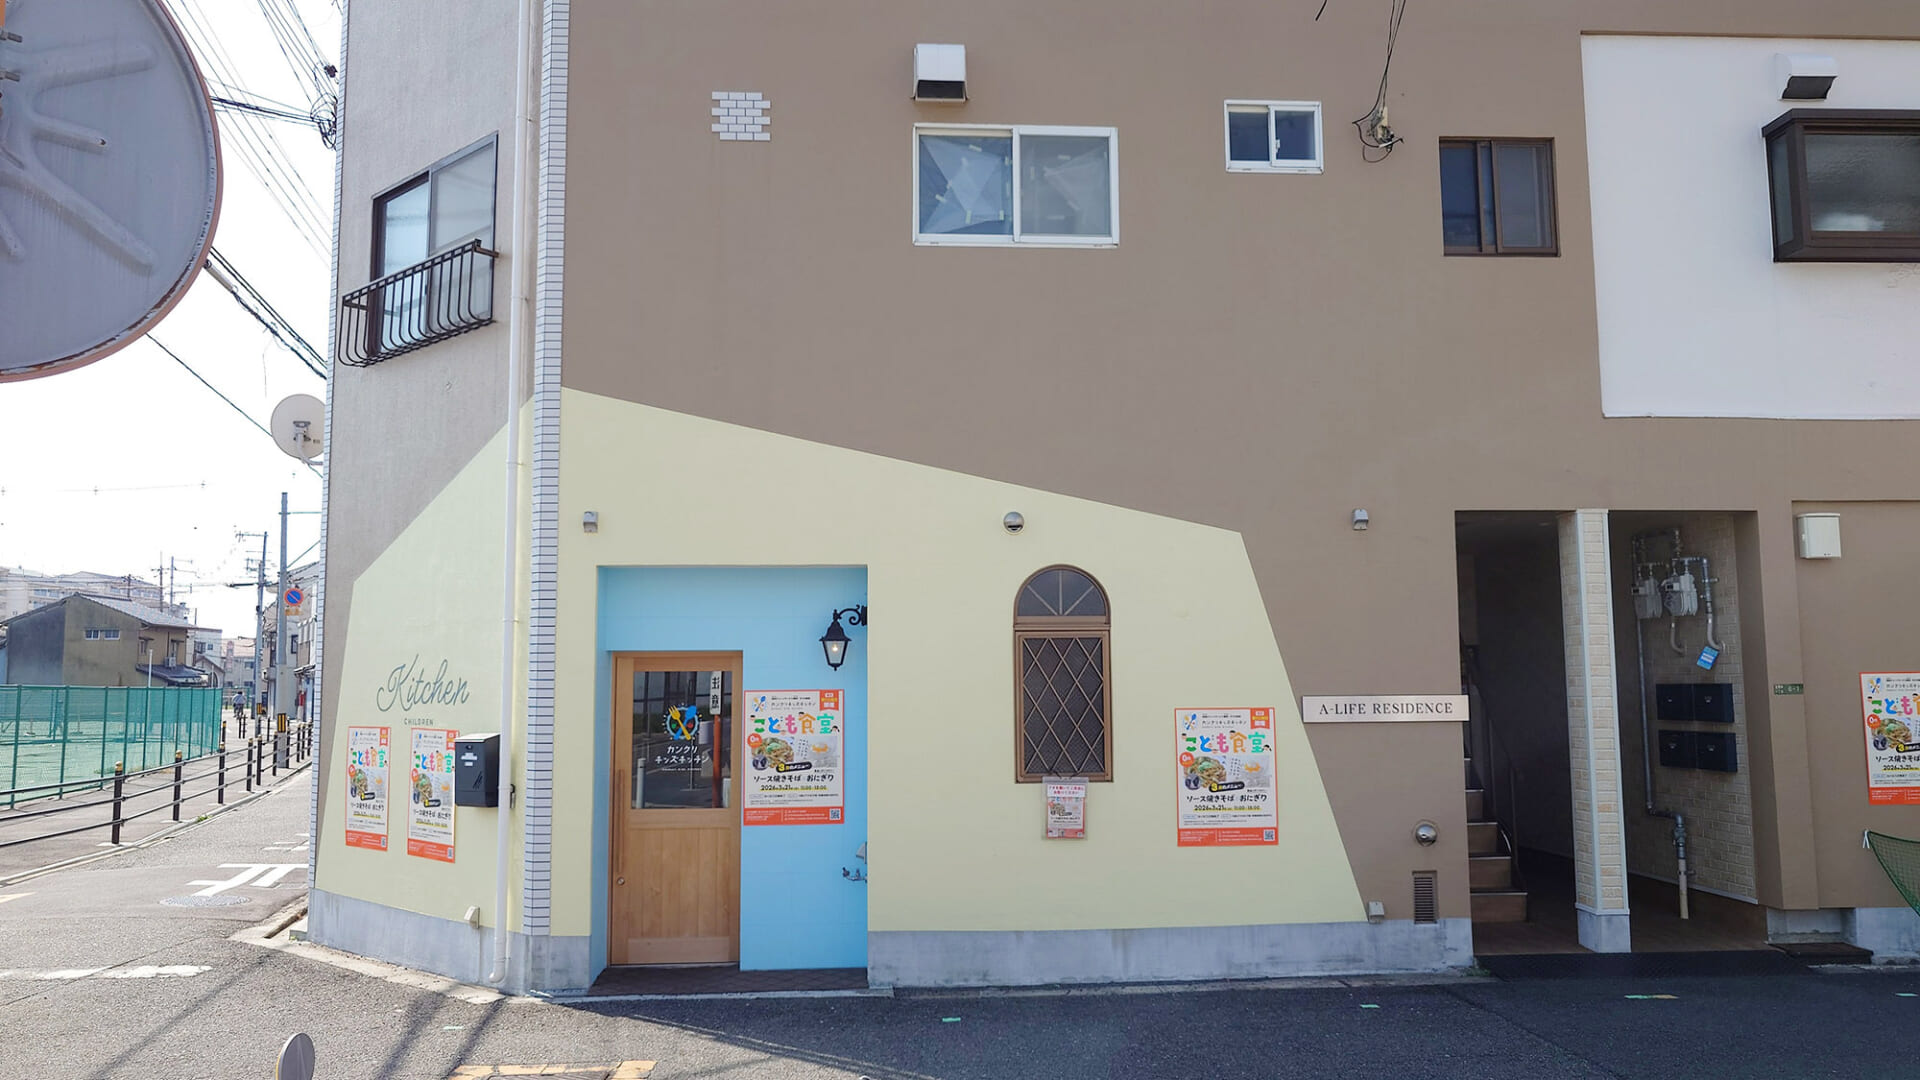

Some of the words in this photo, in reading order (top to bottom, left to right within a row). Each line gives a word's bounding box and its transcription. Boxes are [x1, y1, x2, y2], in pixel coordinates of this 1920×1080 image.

[377, 653, 470, 712] Kitchen
[1319, 703, 1366, 715] A-LIFE
[1373, 702, 1453, 714] RESIDENCE
[404, 717, 434, 726] CHILDREN
[754, 713, 835, 735] こども食堂
[1185, 731, 1266, 753] こども食堂
[667, 745, 698, 754] カンクリ
[655, 755, 709, 765] キッズキッチン
[754, 774, 802, 783] ソース焼きそば
[807, 774, 834, 782] おにぎり
[1187, 794, 1234, 803] ソース焼きそば
[1240, 794, 1267, 802] おにぎり
